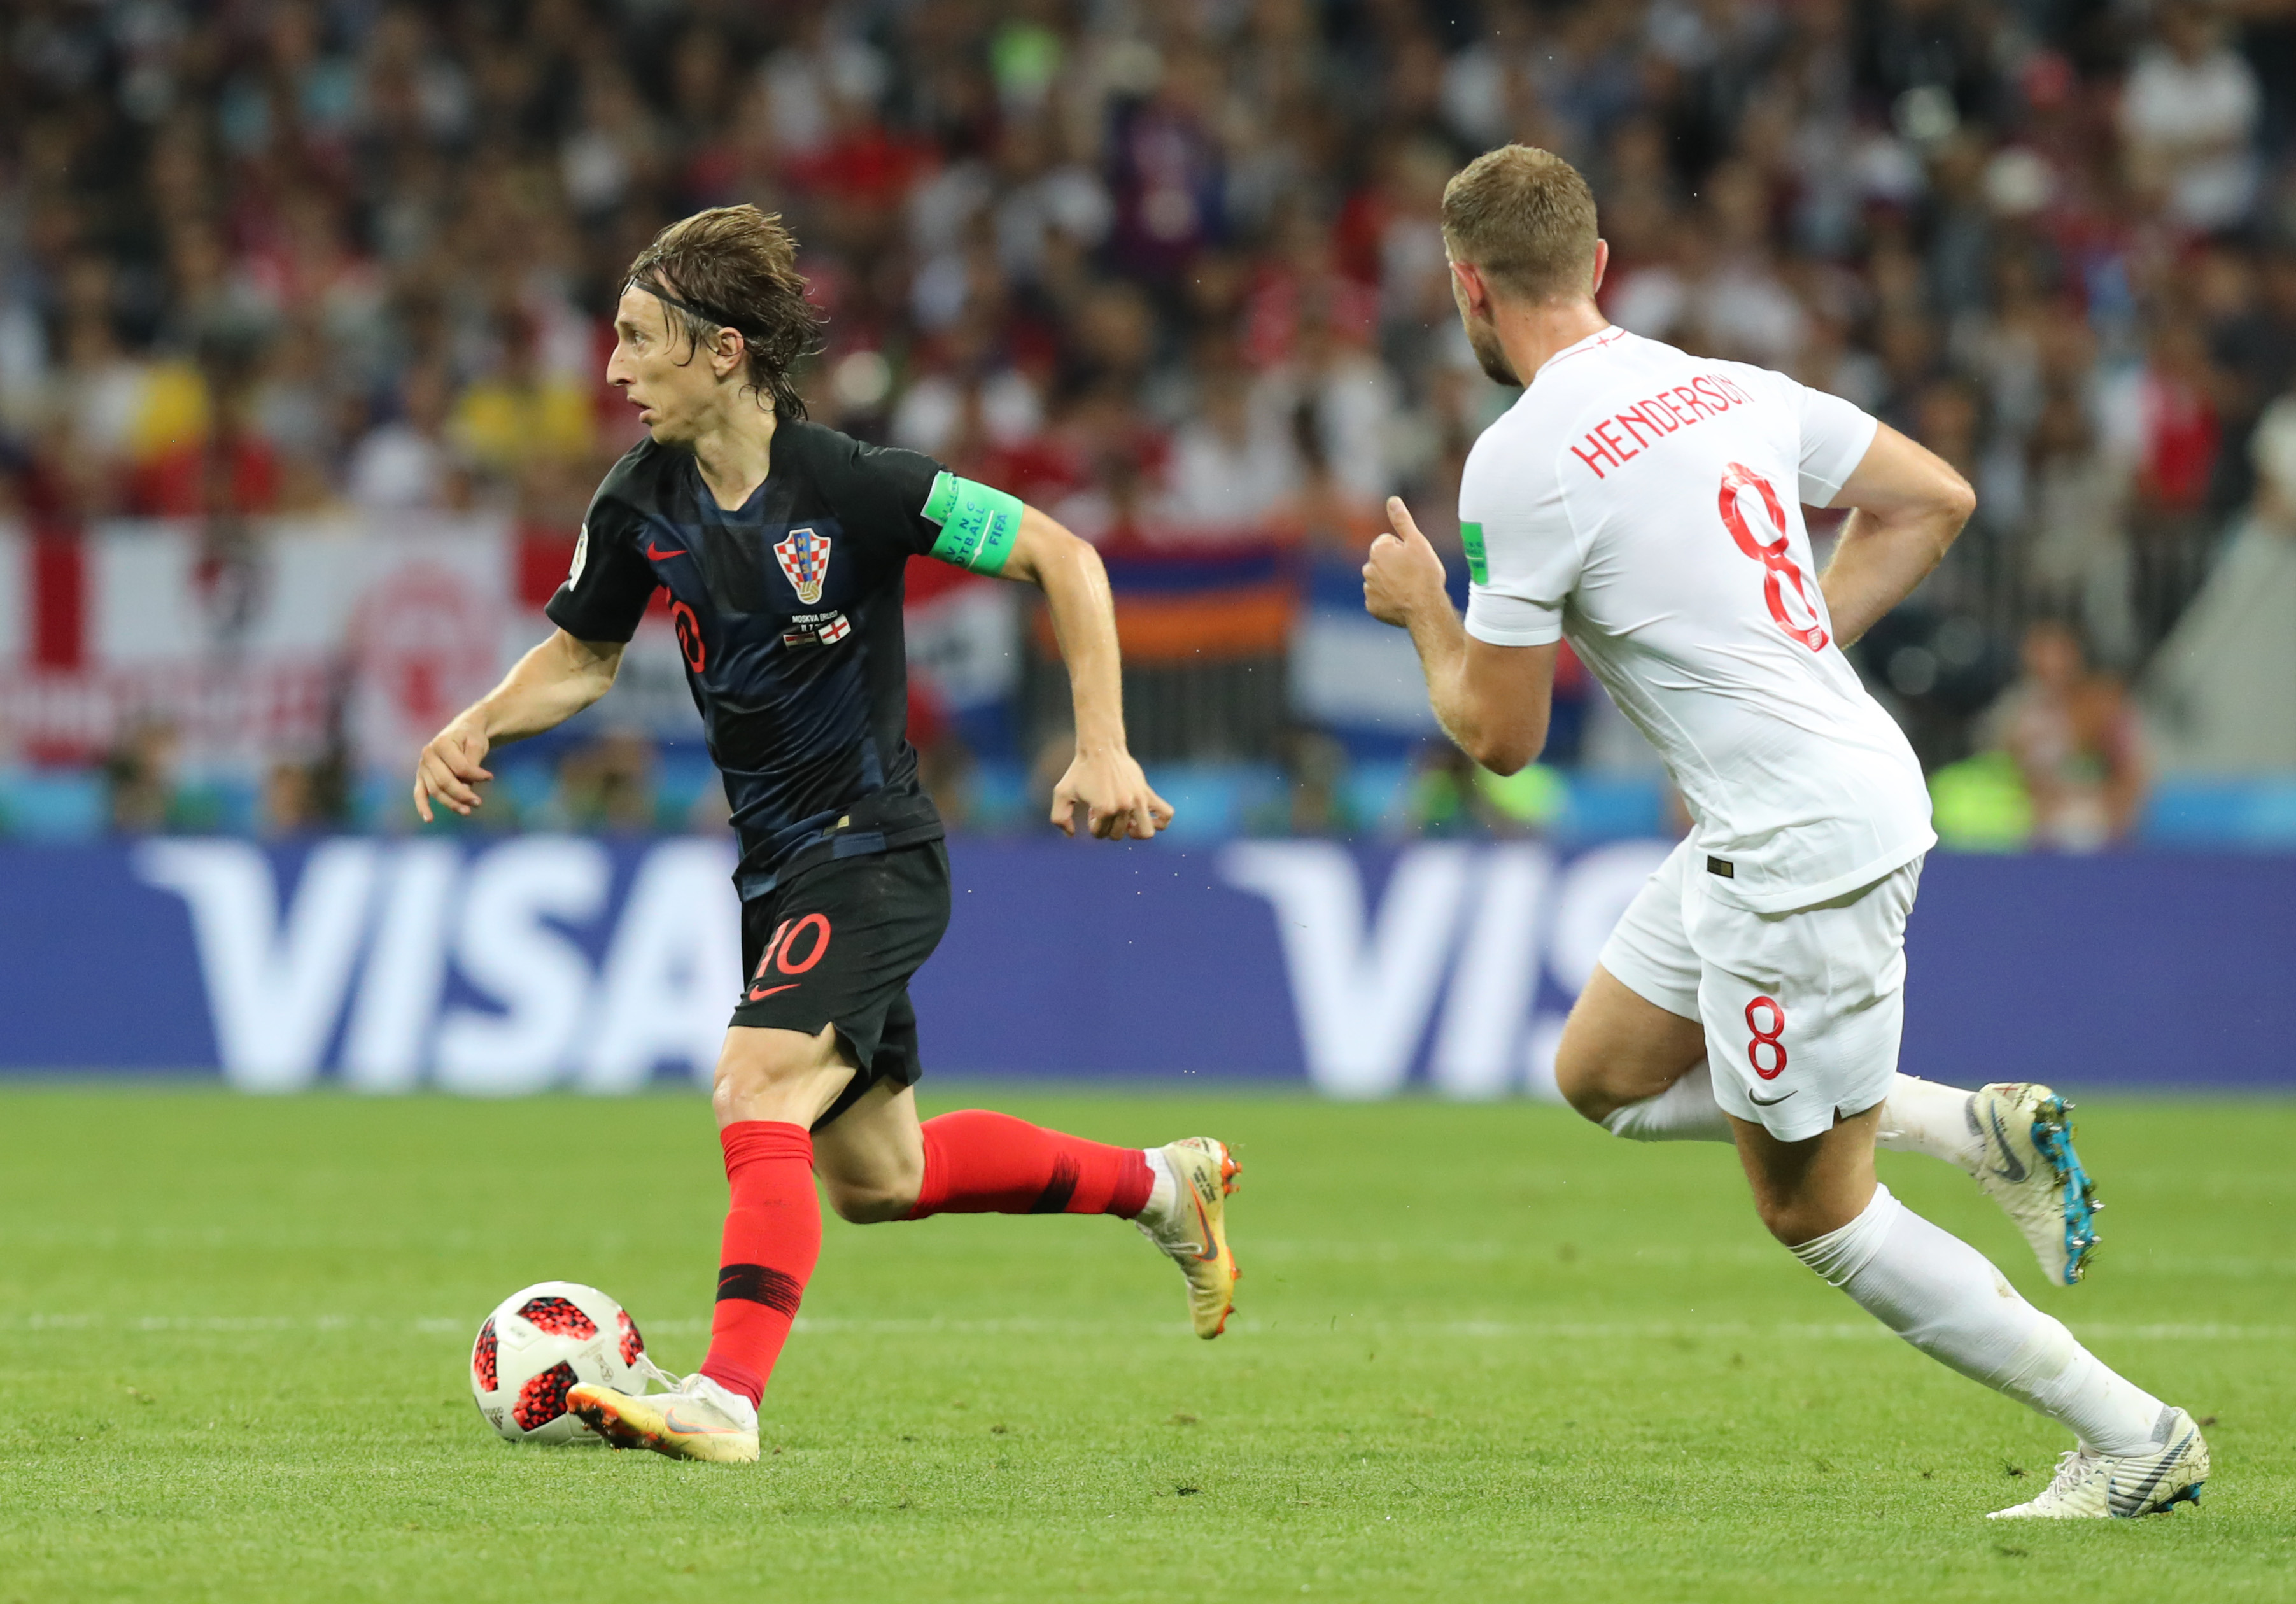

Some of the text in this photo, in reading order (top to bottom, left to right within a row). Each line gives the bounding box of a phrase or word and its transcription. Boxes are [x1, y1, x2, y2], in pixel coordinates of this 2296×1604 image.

[1570, 374, 1754, 479] HENDERSON
[989, 514, 1008, 545] FIFA
[1718, 462, 1829, 652] 8
[792, 614, 819, 623] MOSKVA
[137, 837, 742, 1095] VISA
[756, 913, 831, 978] 10
[1745, 996, 1787, 1080] 8
